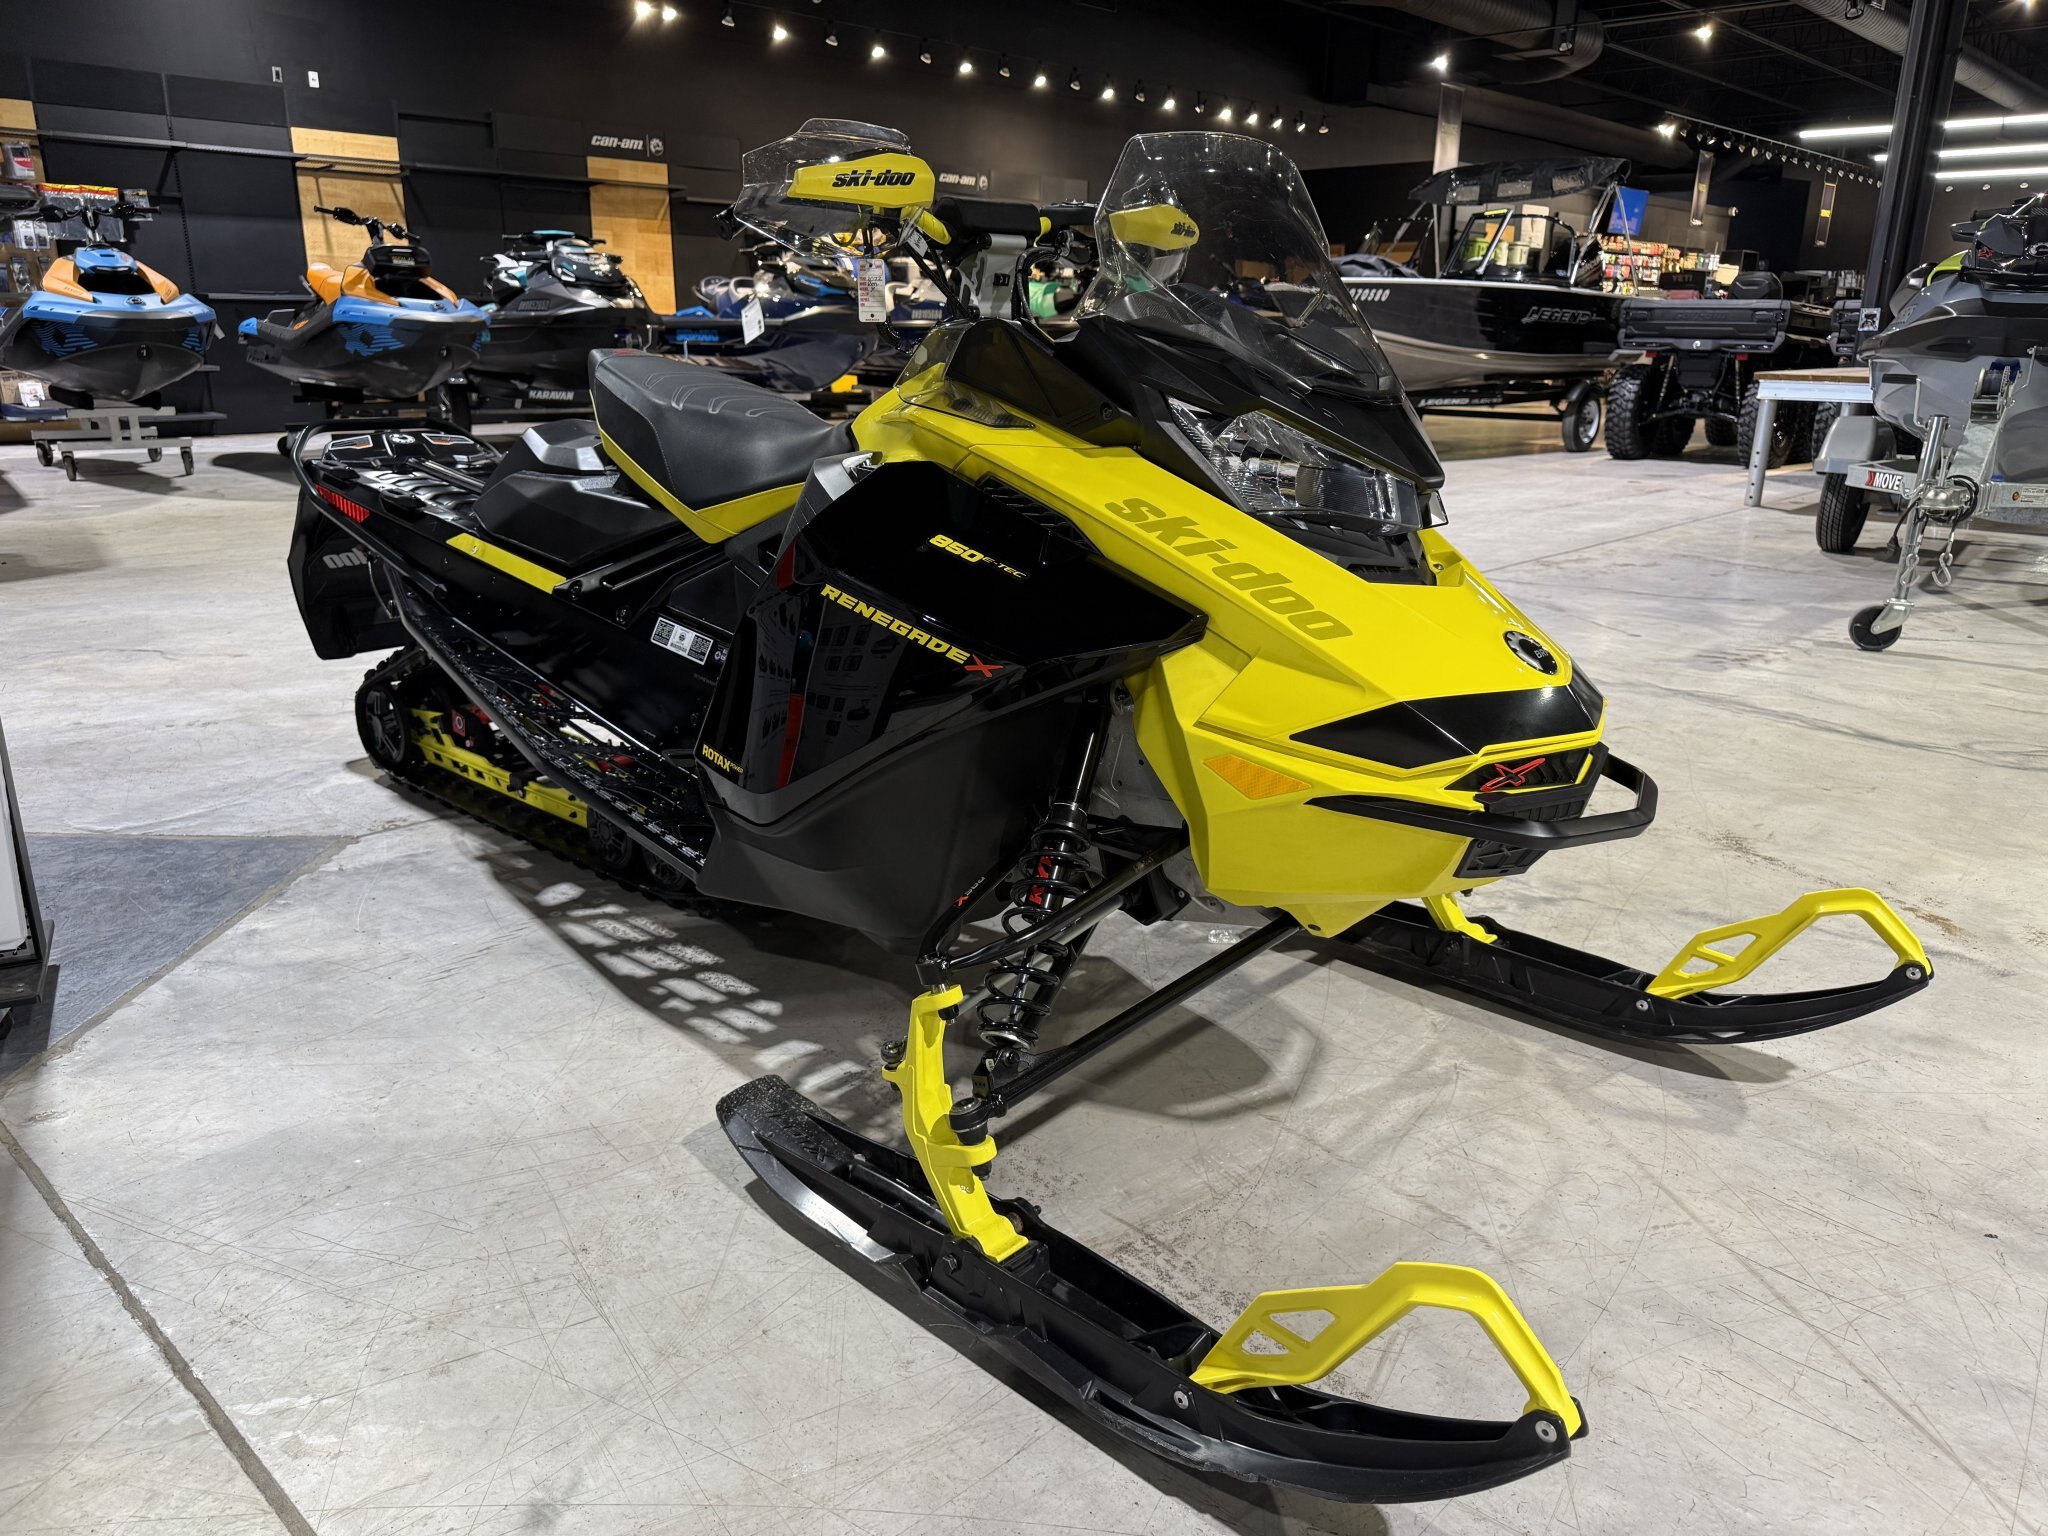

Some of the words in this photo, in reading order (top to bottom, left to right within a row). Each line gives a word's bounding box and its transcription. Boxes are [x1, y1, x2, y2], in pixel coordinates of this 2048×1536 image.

[591, 134, 644, 151] can-am
[832, 169, 916, 188] ski-doo
[938, 172, 977, 186] can-am
[1520, 306, 1592, 324] LEGEND
[528, 390, 575, 400] KARAVAN
[929, 534, 984, 563] 850
[982, 556, 1027, 578] E-TEC
[1104, 497, 1354, 641] ski-doo
[820, 583, 970, 665] RENEGADE
[964, 653, 1004, 678] X
[702, 743, 731, 773] ROTAX
